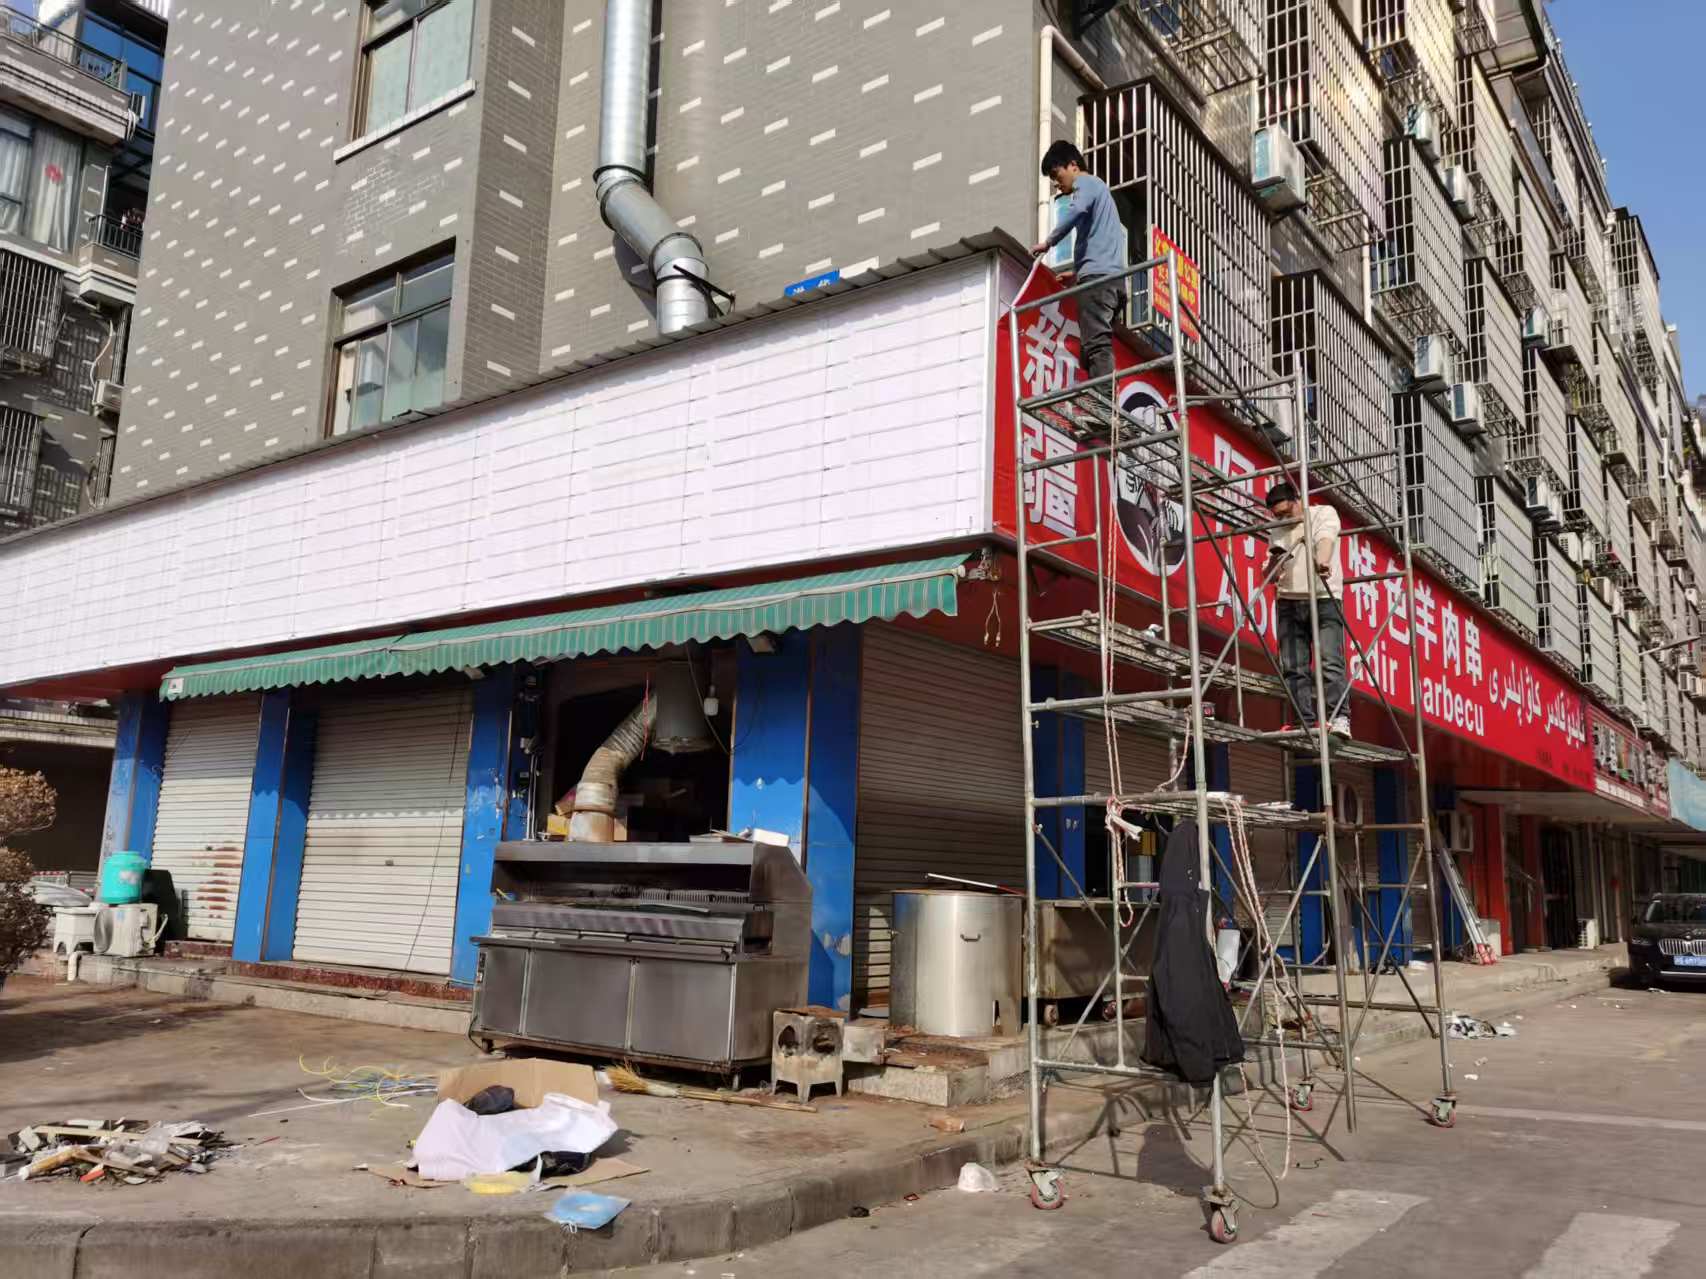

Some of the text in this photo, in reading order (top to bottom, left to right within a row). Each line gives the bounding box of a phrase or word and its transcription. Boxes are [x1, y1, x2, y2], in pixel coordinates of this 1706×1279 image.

[1023, 300, 1081, 537] 新疆
[1348, 534, 1483, 687] 特色羊肉串
